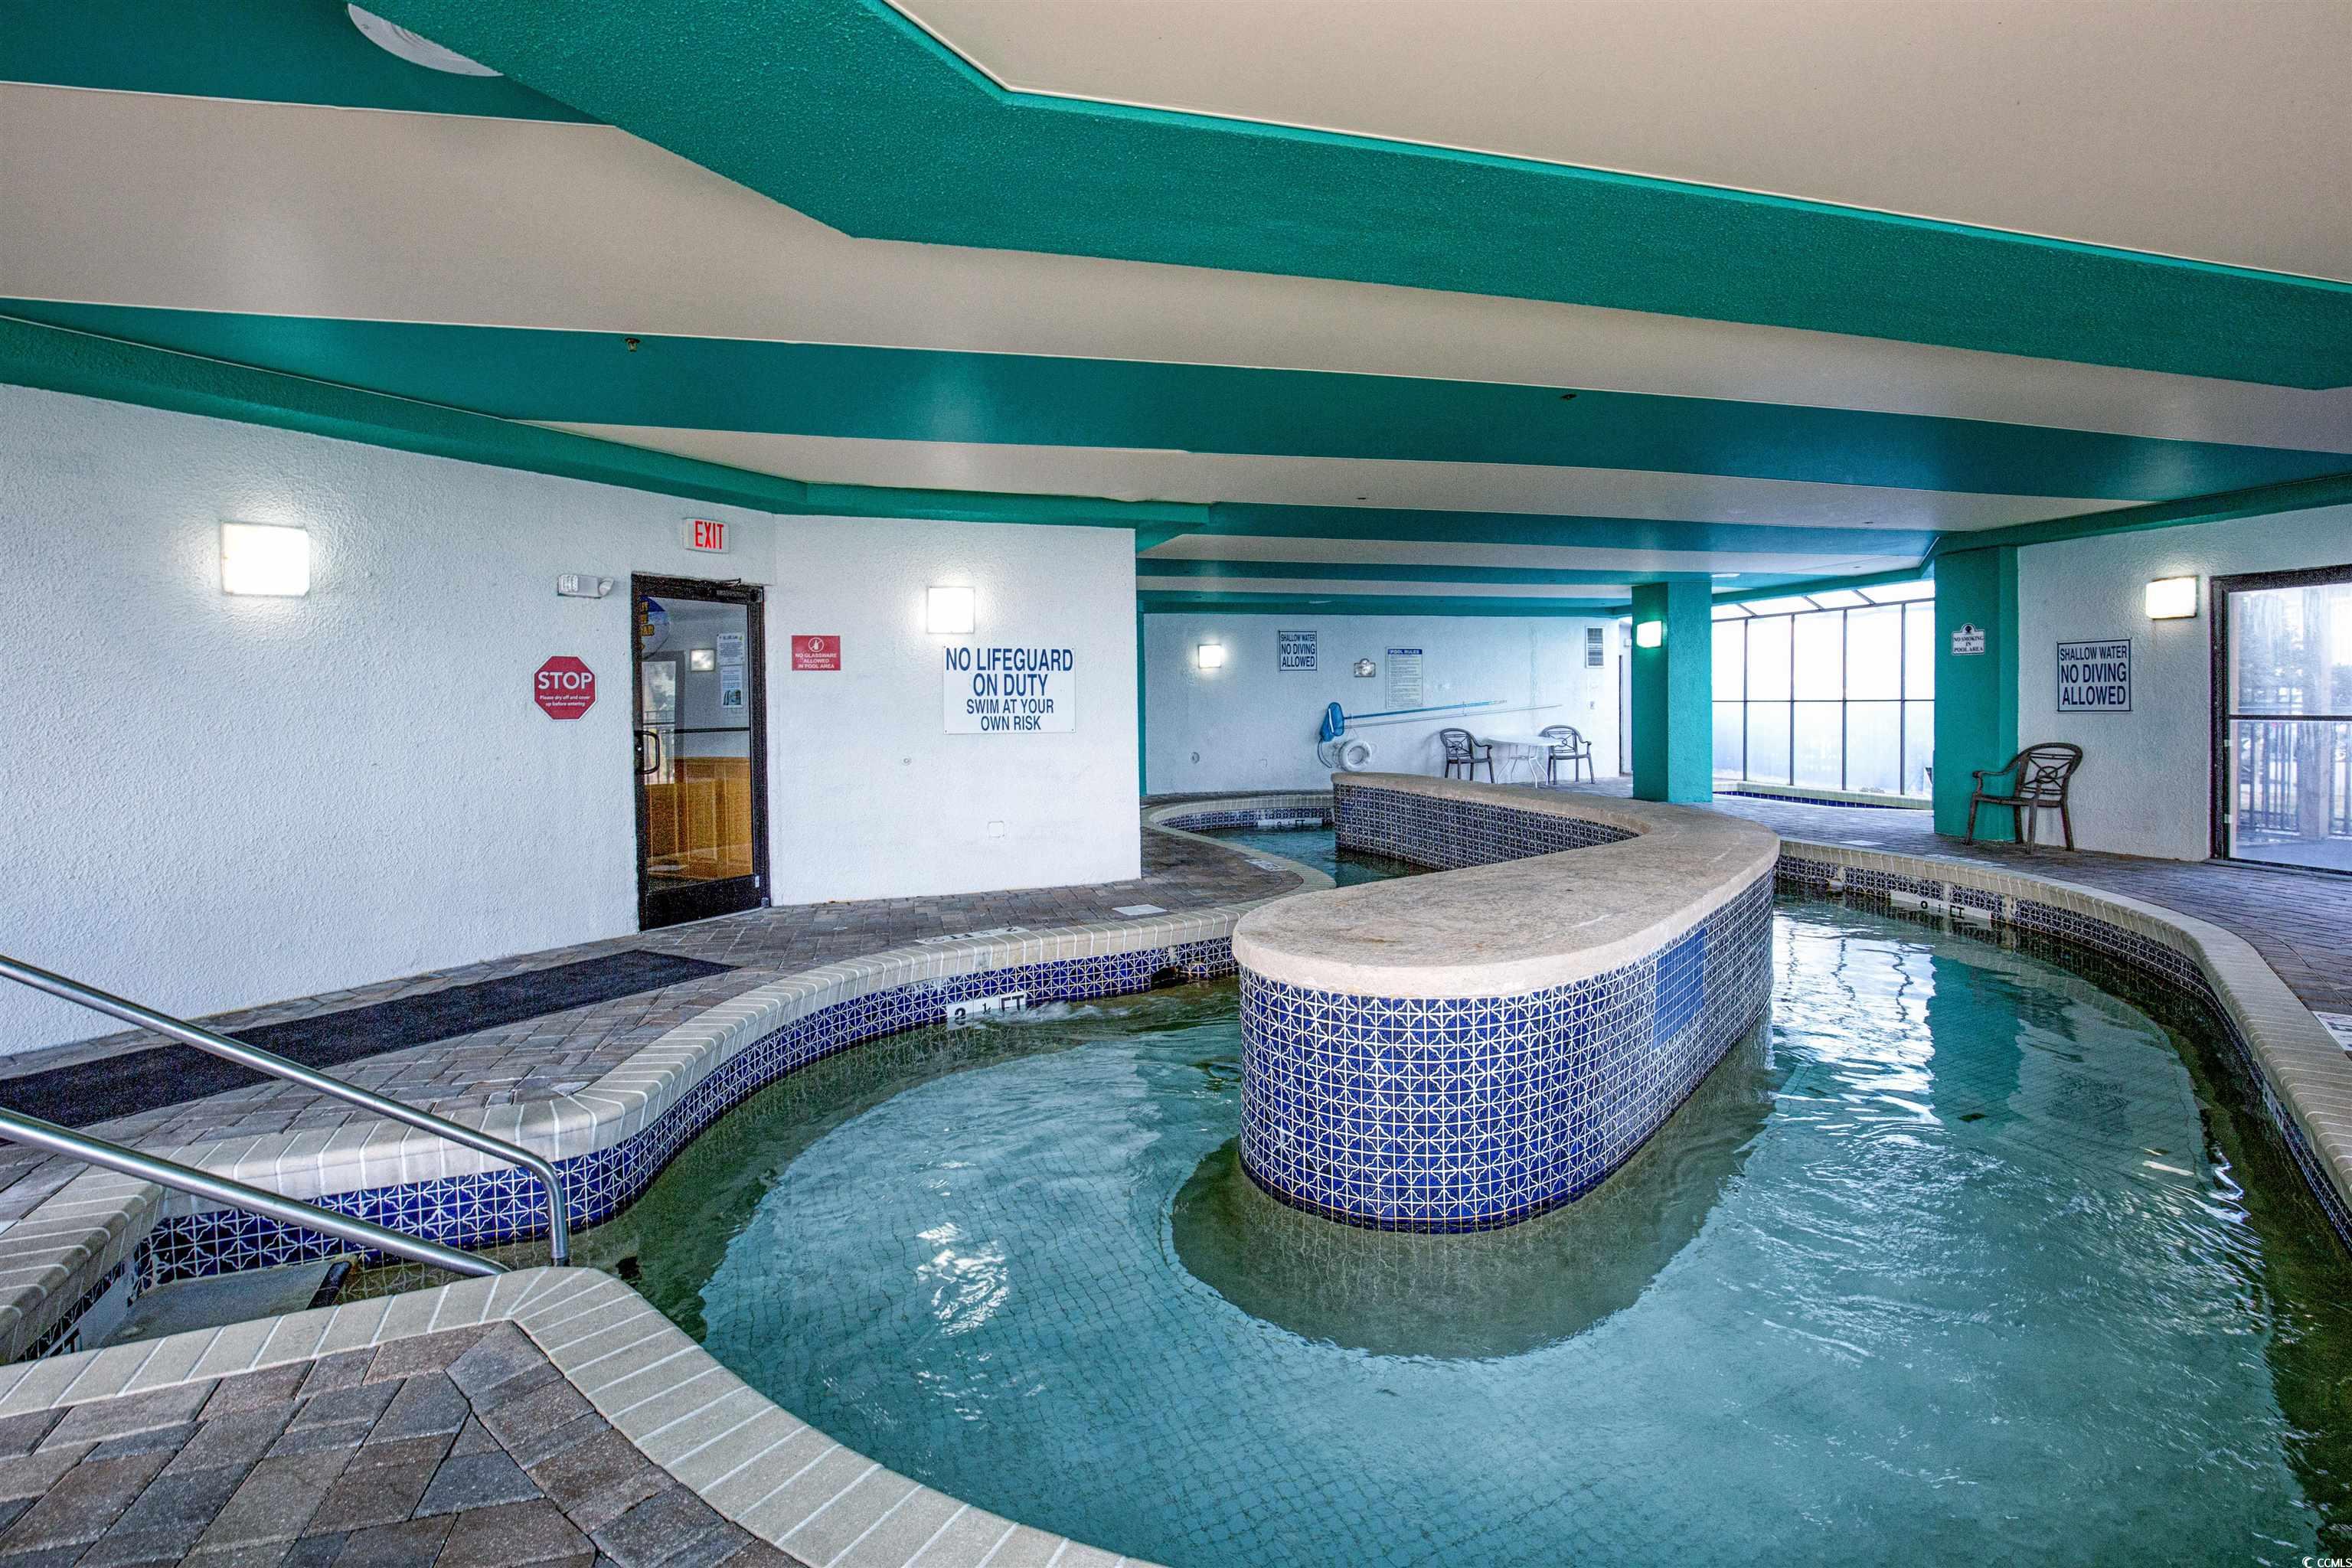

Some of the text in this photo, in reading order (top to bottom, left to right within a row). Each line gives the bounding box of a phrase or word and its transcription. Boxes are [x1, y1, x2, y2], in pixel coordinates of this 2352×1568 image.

[695, 521, 724, 550] EXIT
[1282, 643, 1315, 655] NO DIVING
[2060, 645, 2127, 661] SHALLOW WATER
[946, 647, 1073, 671] NO LIFEGUARD
[1282, 656, 1315, 667] ALLOWED
[538, 671, 593, 690] STOP
[2061, 662, 2126, 683] NO DIVING
[973, 673, 1048, 697] ON DUTY
[2062, 686, 2126, 705] ALLOWED
[966, 698, 1054, 714] SWIM AT YOUR
[981, 715, 1041, 730] OWN RISK
